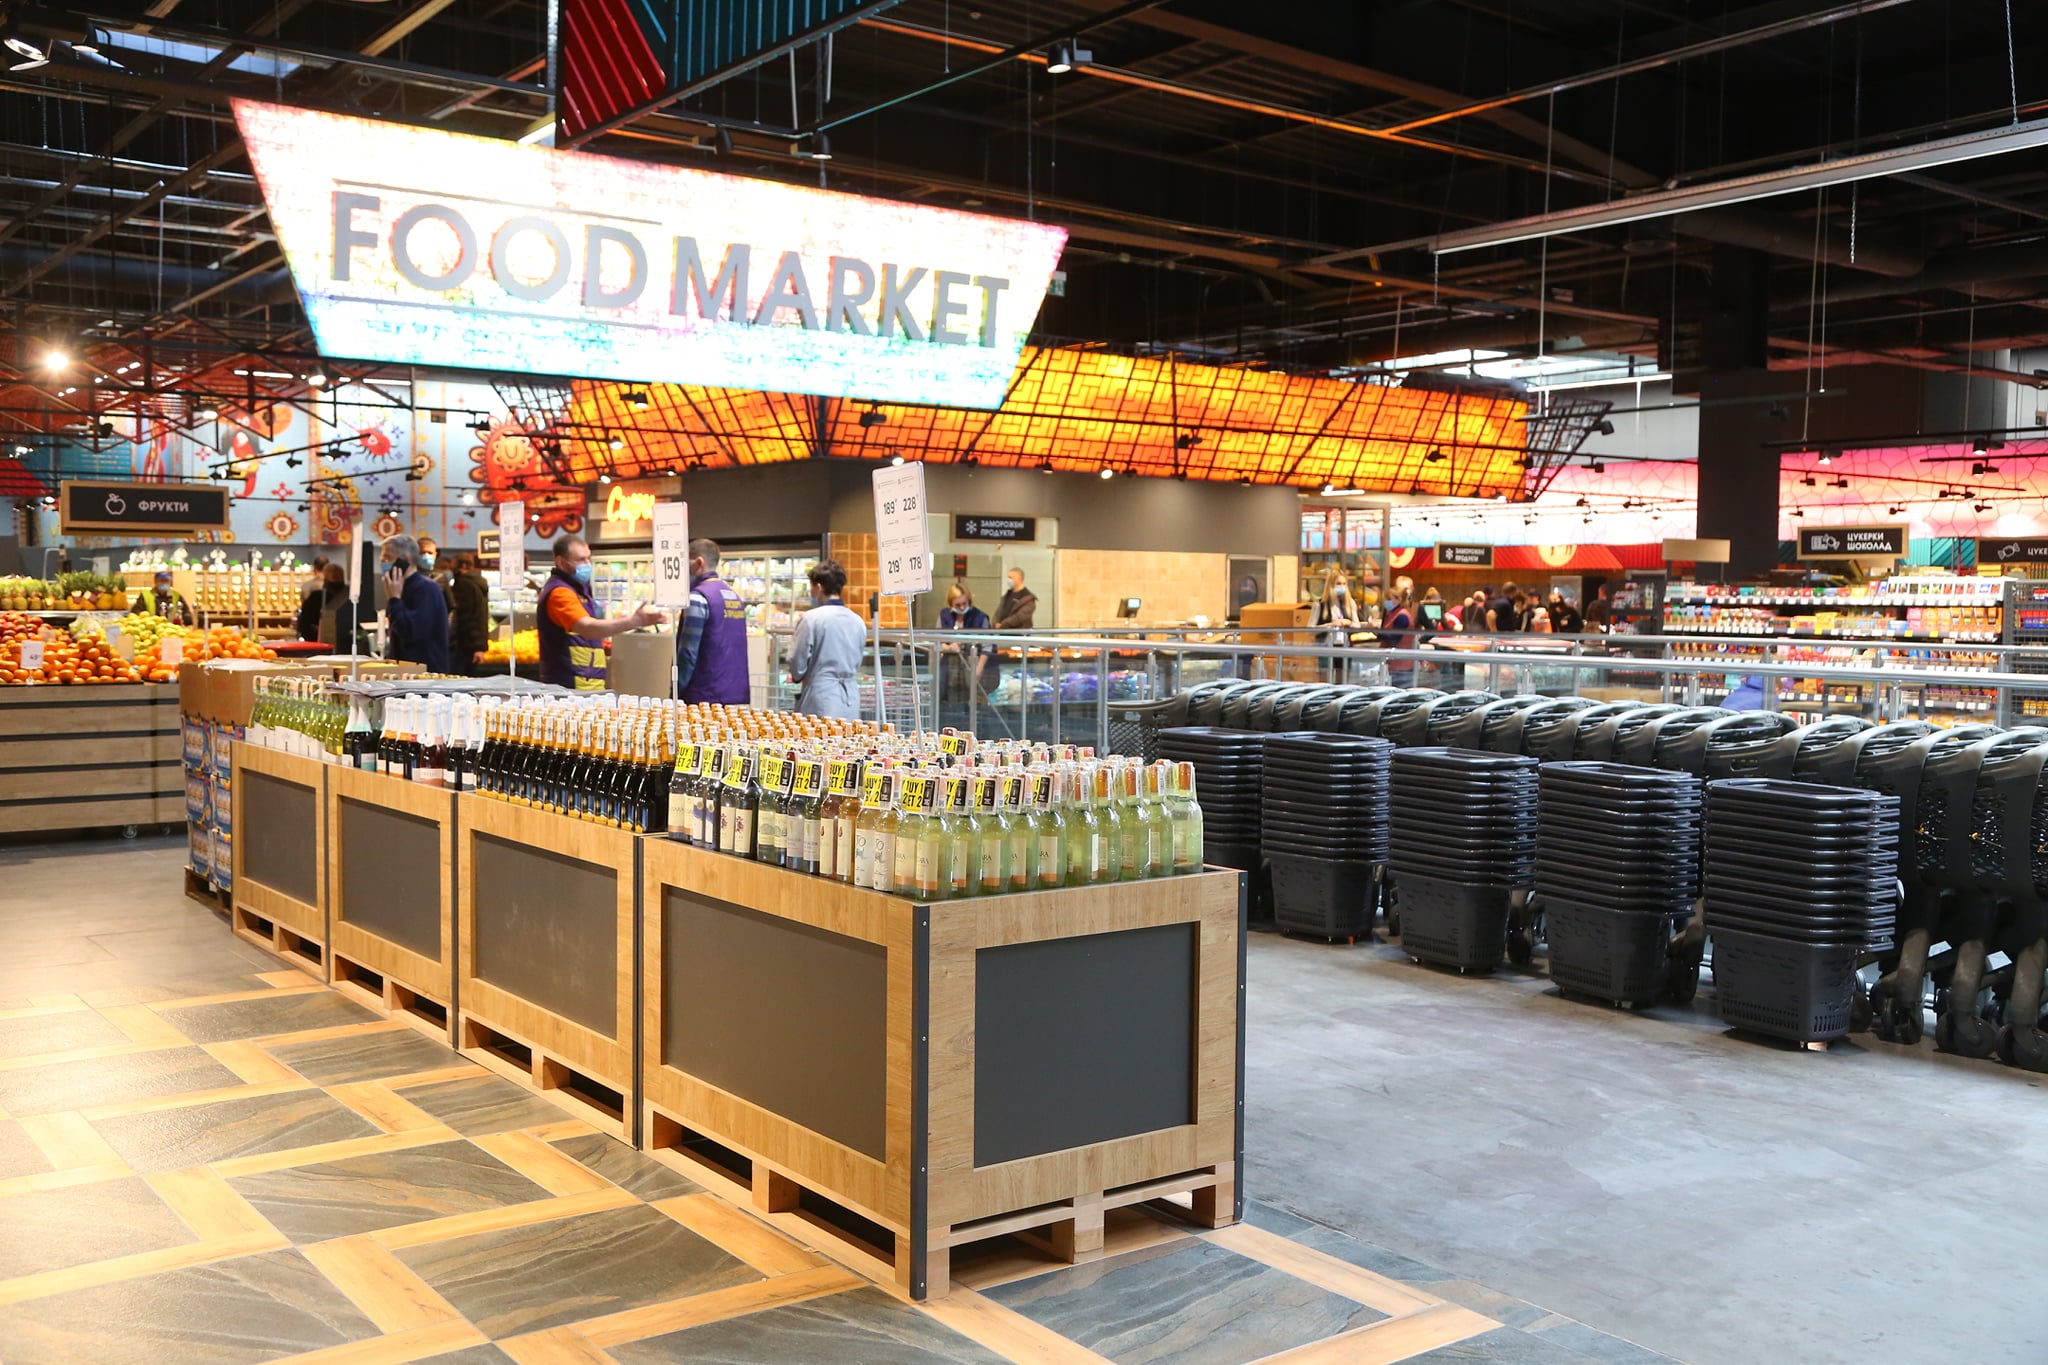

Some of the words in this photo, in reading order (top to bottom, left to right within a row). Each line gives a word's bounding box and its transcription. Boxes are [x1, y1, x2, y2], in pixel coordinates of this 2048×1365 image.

[331, 191, 648, 309] FOOD
[673, 235, 1010, 348] MARKET
[138, 500, 189, 513] ФРУКТИ
[884, 501, 895, 515] 189
[903, 496, 917, 511] 228
[1847, 532, 1885, 541] ЦУКЕРКИ
[1847, 541, 1893, 551] ШОКОЛАД
[662, 556, 681, 580] 159
[888, 559, 901, 574] 219
[909, 556, 922, 570] 178
[767, 760, 779, 774] BUY
[765, 771, 775, 785] GET
[804, 777, 810, 790] 2
[874, 790, 880, 803] 2
[916, 795, 923, 808] 2
